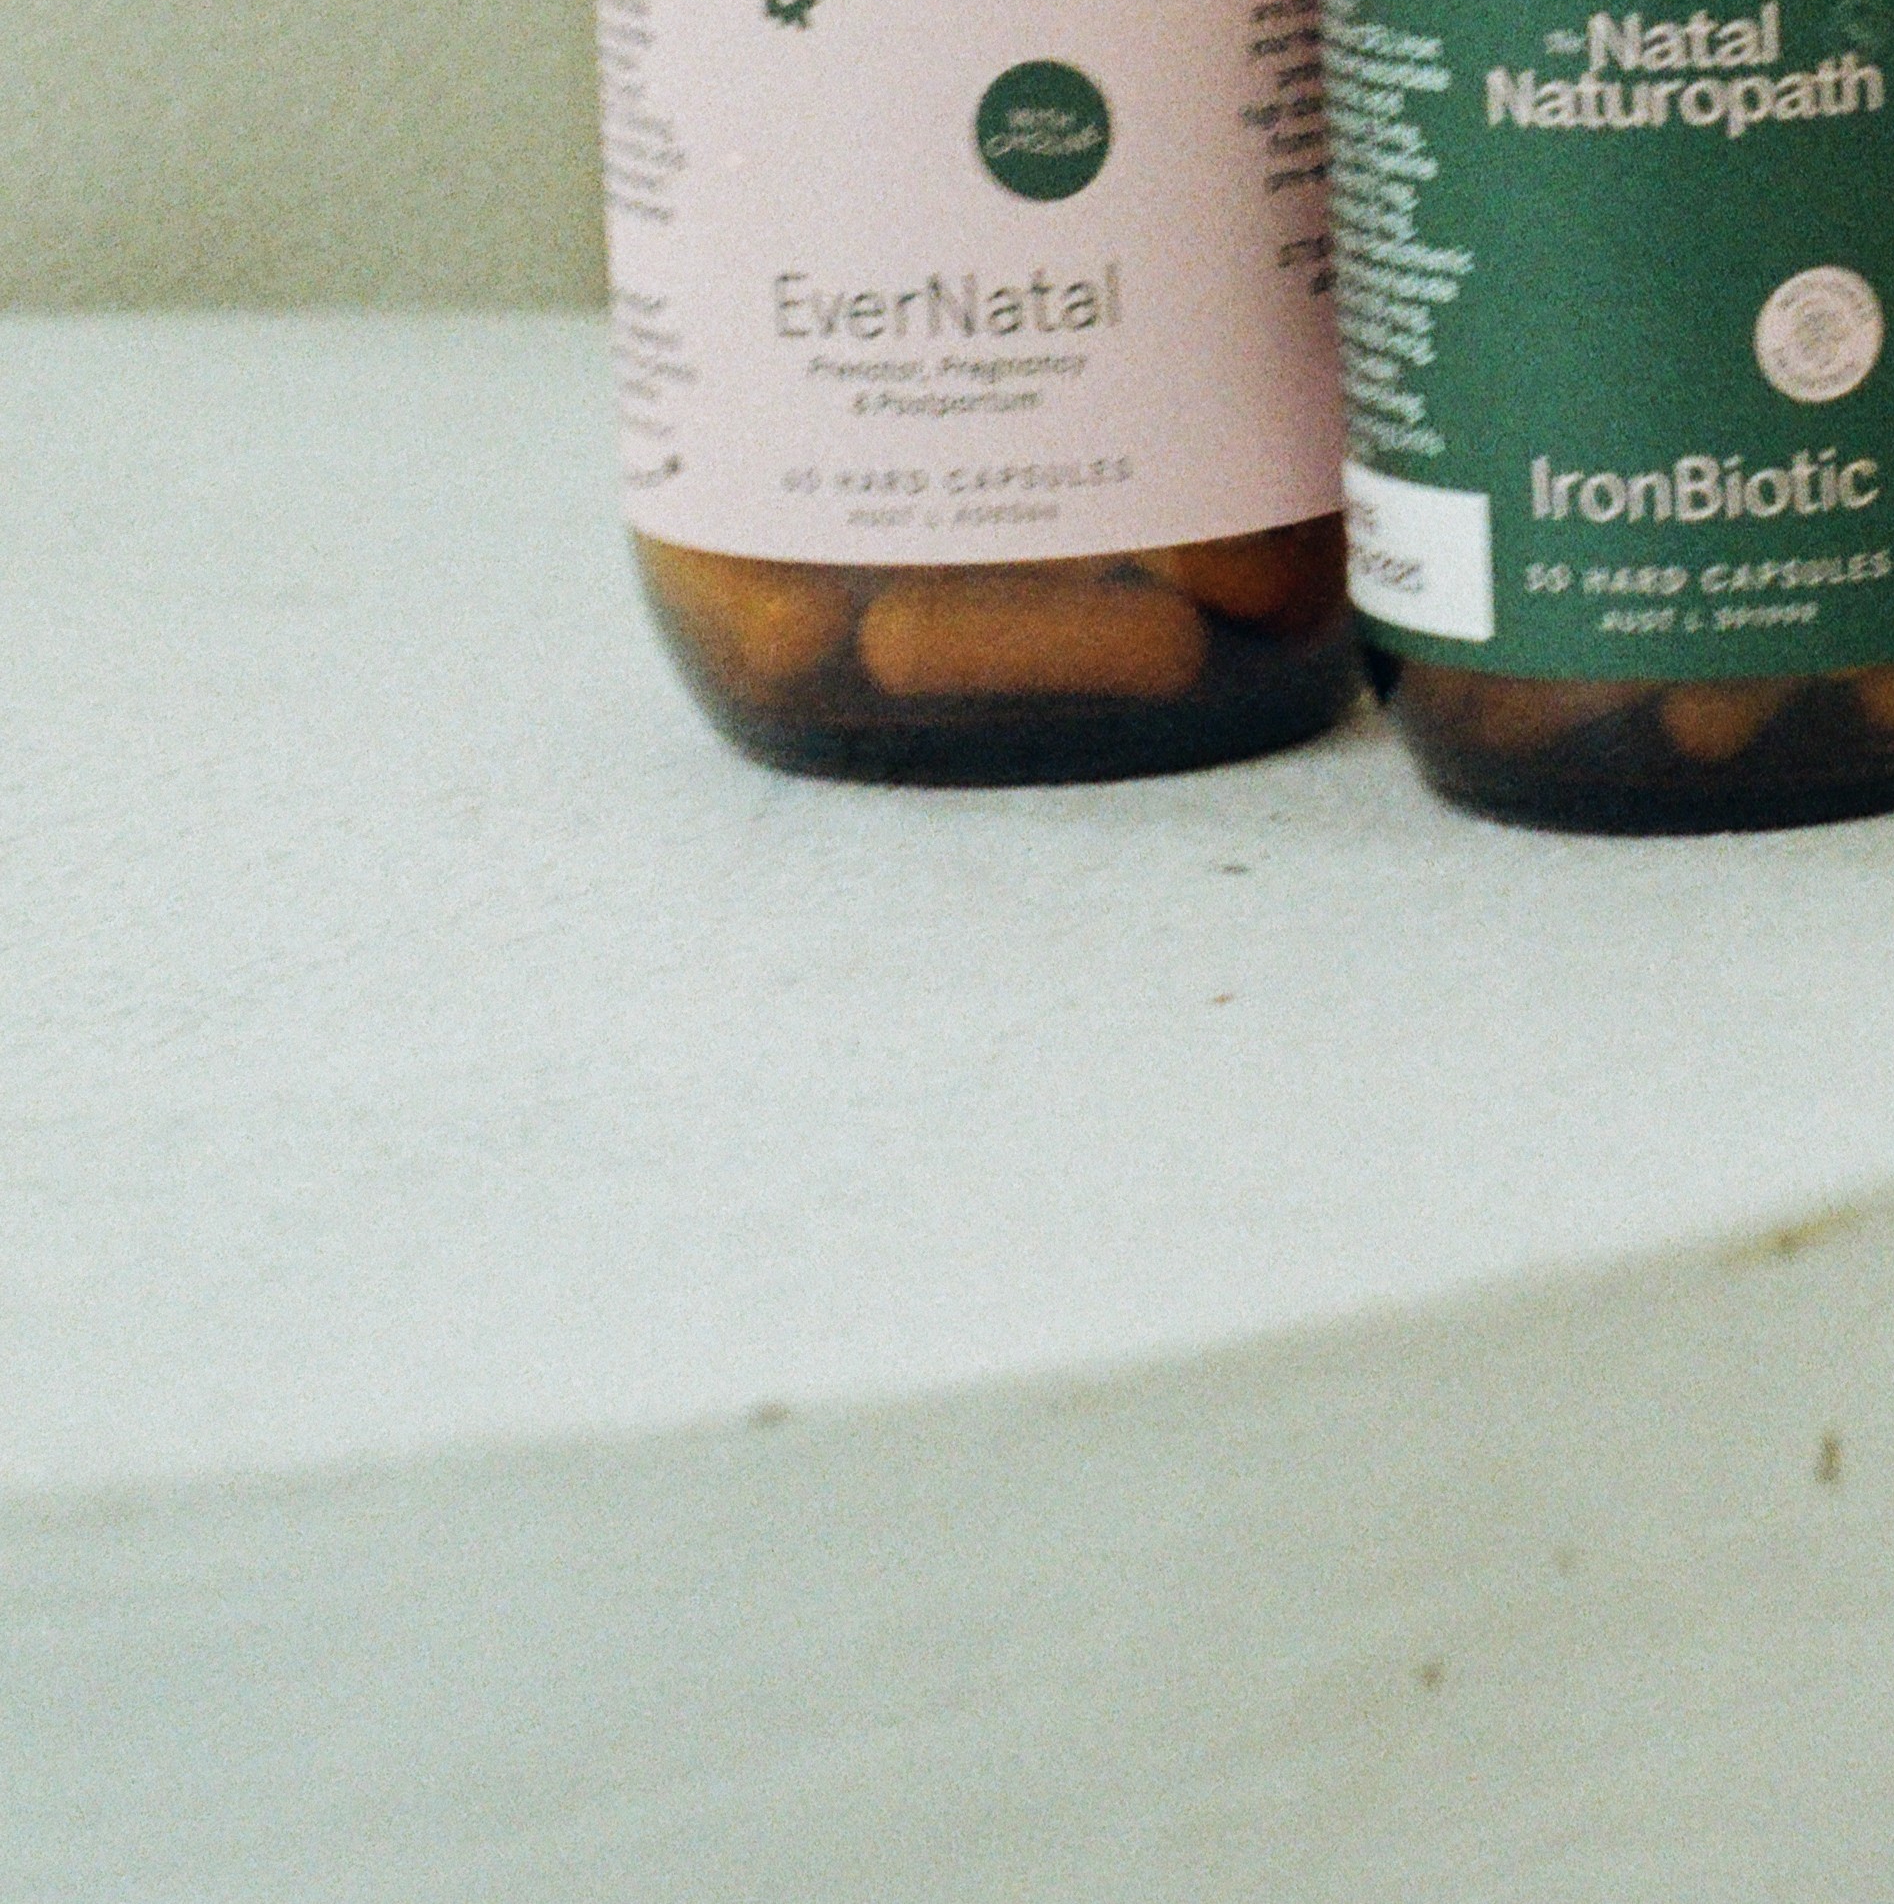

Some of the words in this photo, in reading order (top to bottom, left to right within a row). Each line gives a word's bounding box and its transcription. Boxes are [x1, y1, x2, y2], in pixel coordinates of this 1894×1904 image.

[1586, 1, 1782, 72] Natal
[1485, 52, 1885, 139] Naturopath
[771, 264, 1121, 342] EverNatal
[833, 468, 930, 496] HARD
[942, 455, 1133, 496] CAPSULES
[1529, 446, 1880, 524] IronBiotic
[1582, 563, 1689, 597] HARD
[1700, 548, 1892, 595] CAPSULES
